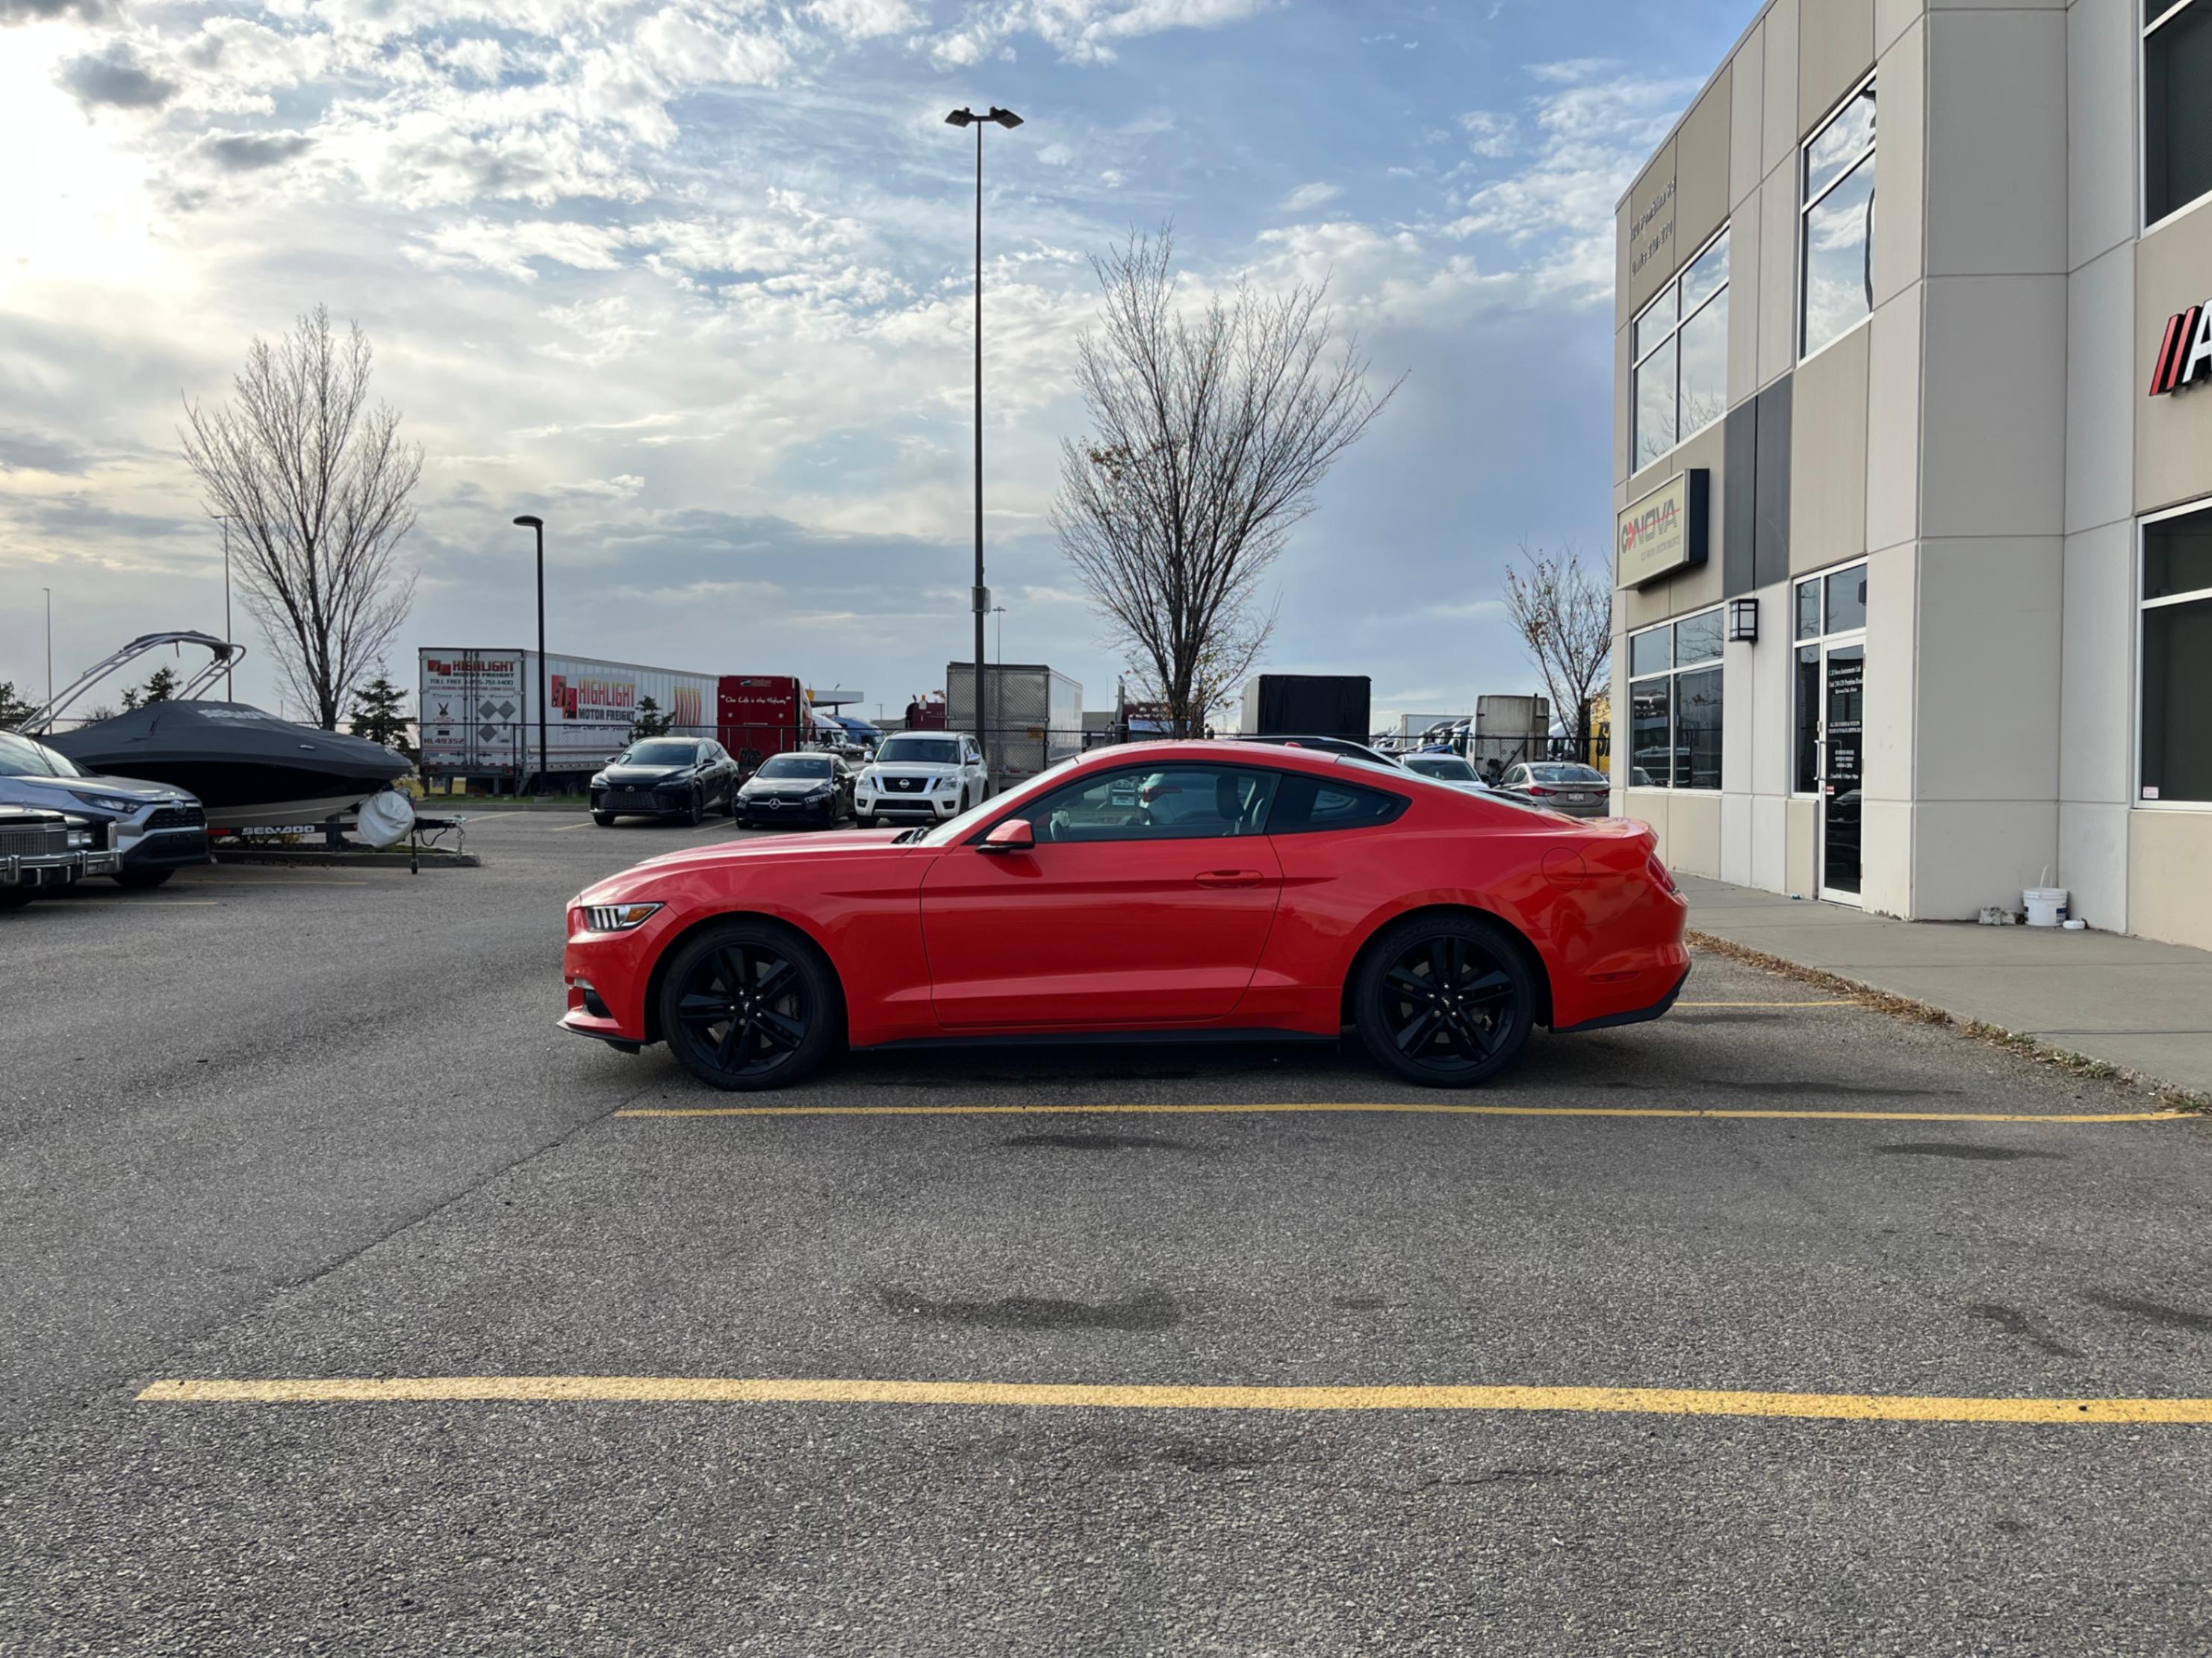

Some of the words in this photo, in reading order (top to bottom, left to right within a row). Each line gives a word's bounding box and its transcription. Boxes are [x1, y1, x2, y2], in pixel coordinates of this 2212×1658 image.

[453, 660, 514, 671] HIGHLIGHT
[579, 678, 636, 707] HIGHLIGHT
[579, 708, 605, 720] MOTOR
[606, 709, 635, 723] FREIGHT
